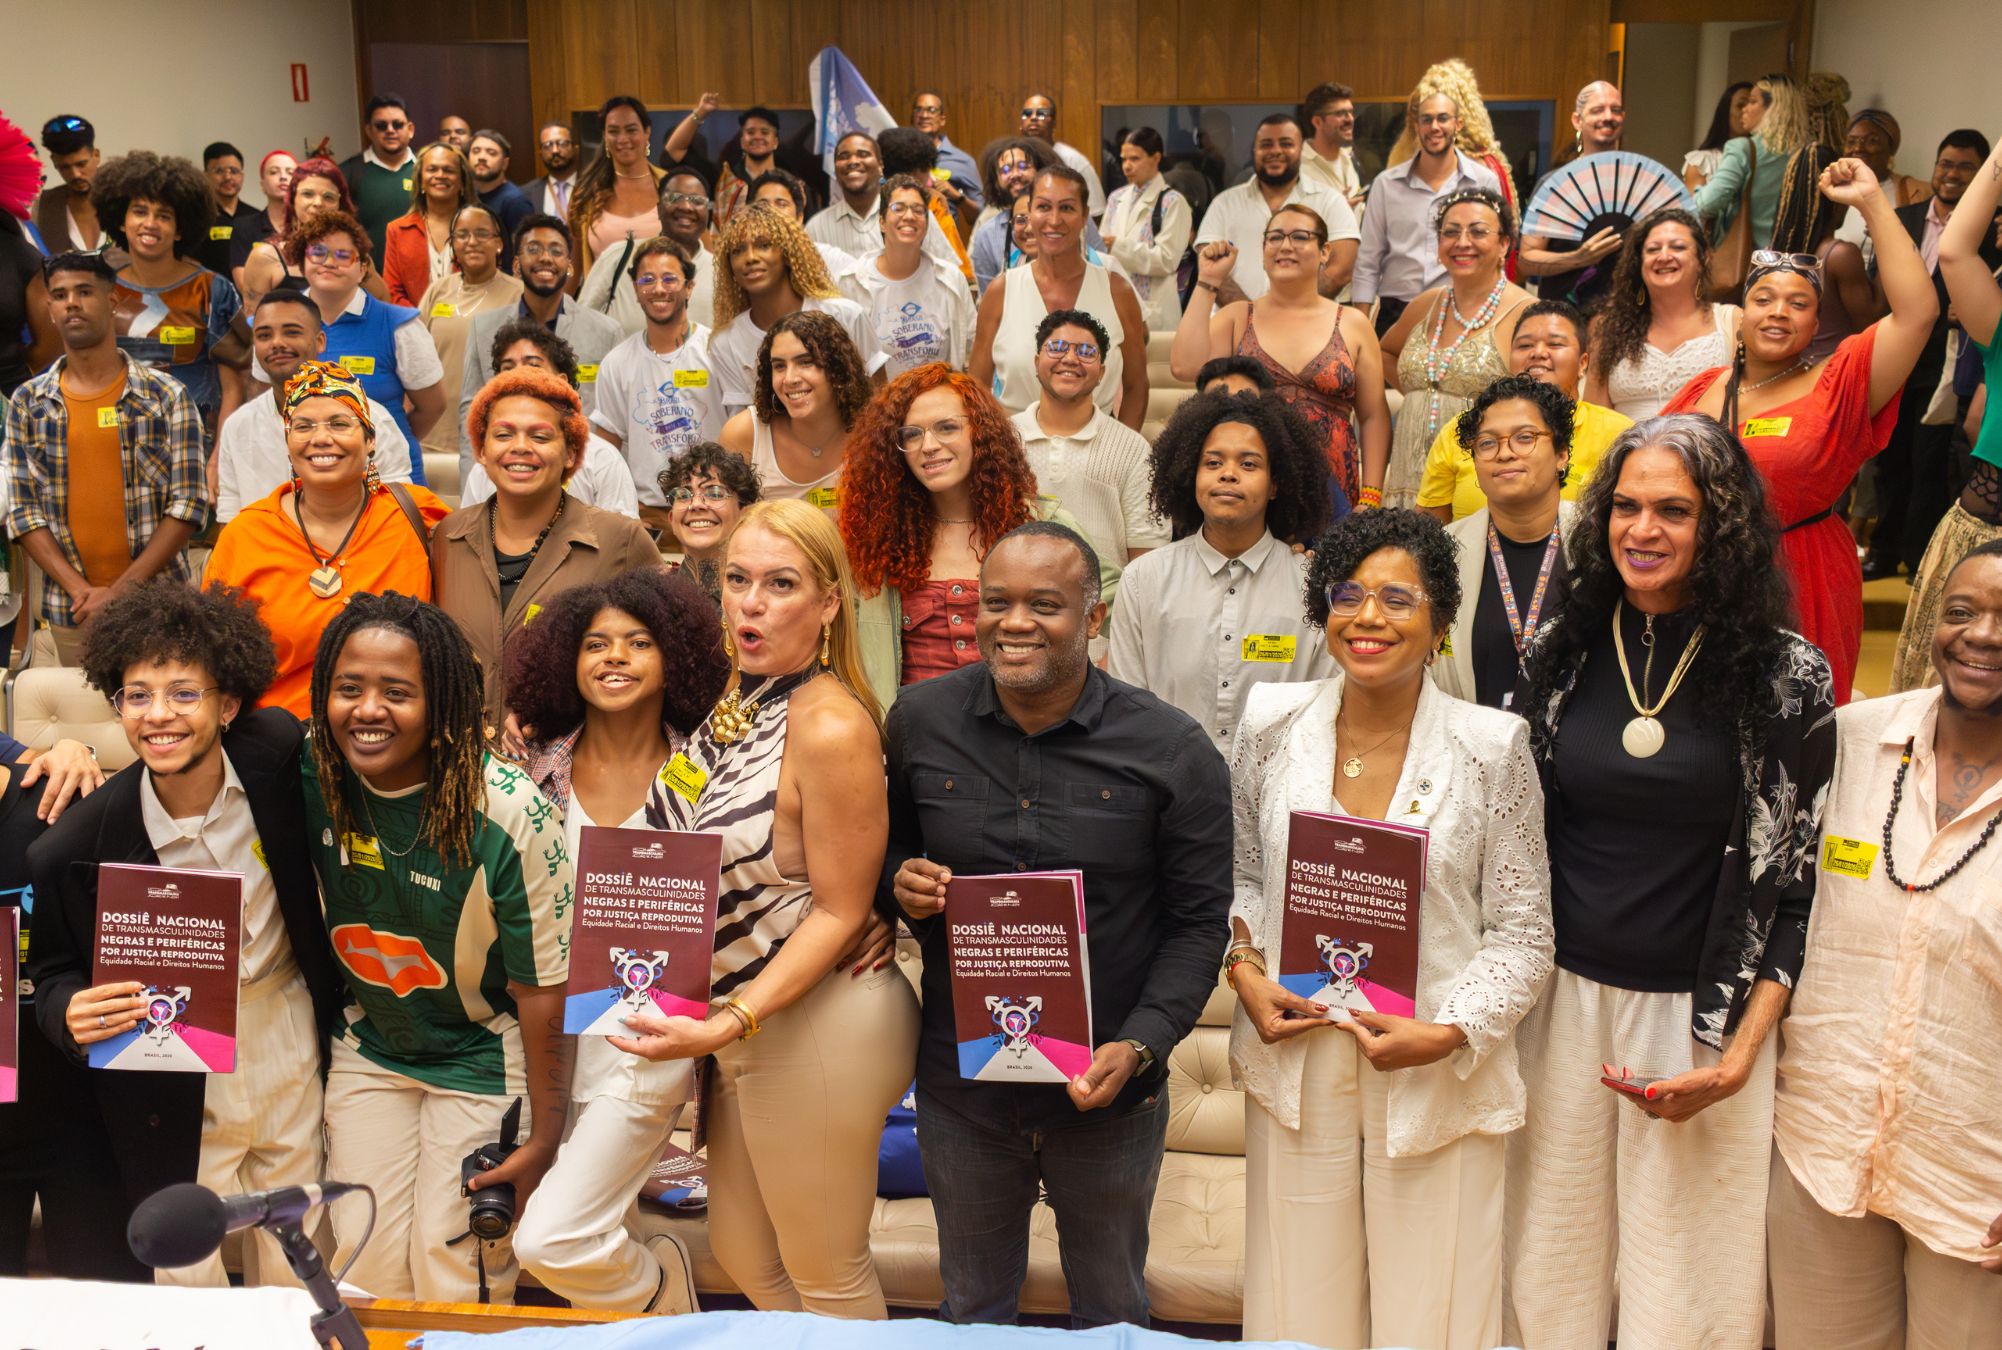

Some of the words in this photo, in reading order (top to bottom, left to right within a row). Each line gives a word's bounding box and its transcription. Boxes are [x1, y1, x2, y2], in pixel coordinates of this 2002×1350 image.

[651, 406, 694, 421] SOBERANO
[410, 871, 441, 891] TUCUXI
[586, 872, 633, 886] DOSSIÊ
[640, 876, 706, 891] NACIONAL
[1292, 859, 1336, 877] DOSSIÊ
[1342, 869, 1407, 890] NACIONAL
[585, 885, 597, 893] DE
[599, 885, 705, 900] TRANSMASCULINIDADES
[1292, 871, 1303, 880] DE
[1304, 874, 1407, 899] TRANSMASCULINIDADES
[584, 896, 627, 908] NEGRAS
[629, 899, 636, 908] E
[638, 899, 704, 913] PERIFÉRICAS
[1290, 882, 1330, 898] NEGRAS
[1332, 889, 1339, 899] E
[1341, 891, 1407, 912] PERIFÉRICAS
[1290, 894, 1307, 905] POR
[1309, 897, 1343, 912] JUSTIÇA
[1345, 904, 1406, 922] REPRODUTIVA
[102, 912, 150, 925] DOSSIÊ
[157, 915, 226, 930] NACIONAL
[583, 909, 602, 918] POR
[603, 910, 640, 921] JUSTIÇA
[642, 912, 703, 925] REPRODUTIVA
[1289, 903, 1318, 916] Equidade
[1320, 909, 1340, 920] Racial
[1346, 914, 1373, 925] Direitos
[1374, 917, 1406, 931] Humanos
[102, 924, 114, 932] DE
[116, 925, 225, 939] TRANSMASCULINIDADES
[582, 918, 614, 929] Equidade
[615, 920, 636, 929] Racial
[643, 921, 670, 931] Direitos
[671, 924, 703, 934] Humanos
[952, 922, 996, 935] DOSSIÊ
[1001, 925, 1067, 935] NACIONAL
[101, 935, 145, 946] NEGRAS
[147, 937, 154, 946] E
[156, 936, 225, 951] PERIFÉRICAS
[953, 937, 964, 945] DE
[965, 936, 1067, 945] TRANSMASCULINIDADES
[101, 947, 120, 956] POR
[122, 948, 159, 960] JUSTIÇA
[161, 950, 224, 962] REPRODUTIVA
[954, 948, 994, 957] NEGRAS
[996, 948, 1002, 957] E
[1004, 946, 1069, 957] PERIFÉRICAS
[100, 956, 132, 967] Equidade
[134, 958, 155, 966] Racial
[163, 959, 190, 968] Direitos
[192, 962, 225, 970] Humanos
[955, 960, 972, 968] POR
[973, 960, 1008, 970] JUSTIÇA
[1009, 960, 1070, 968] REPRODUTIVA
[956, 969, 984, 979] Equidade
[985, 969, 1005, 977] Racial
[1012, 969, 1038, 977] Direitos
[1040, 969, 1071, 977] Humanos
